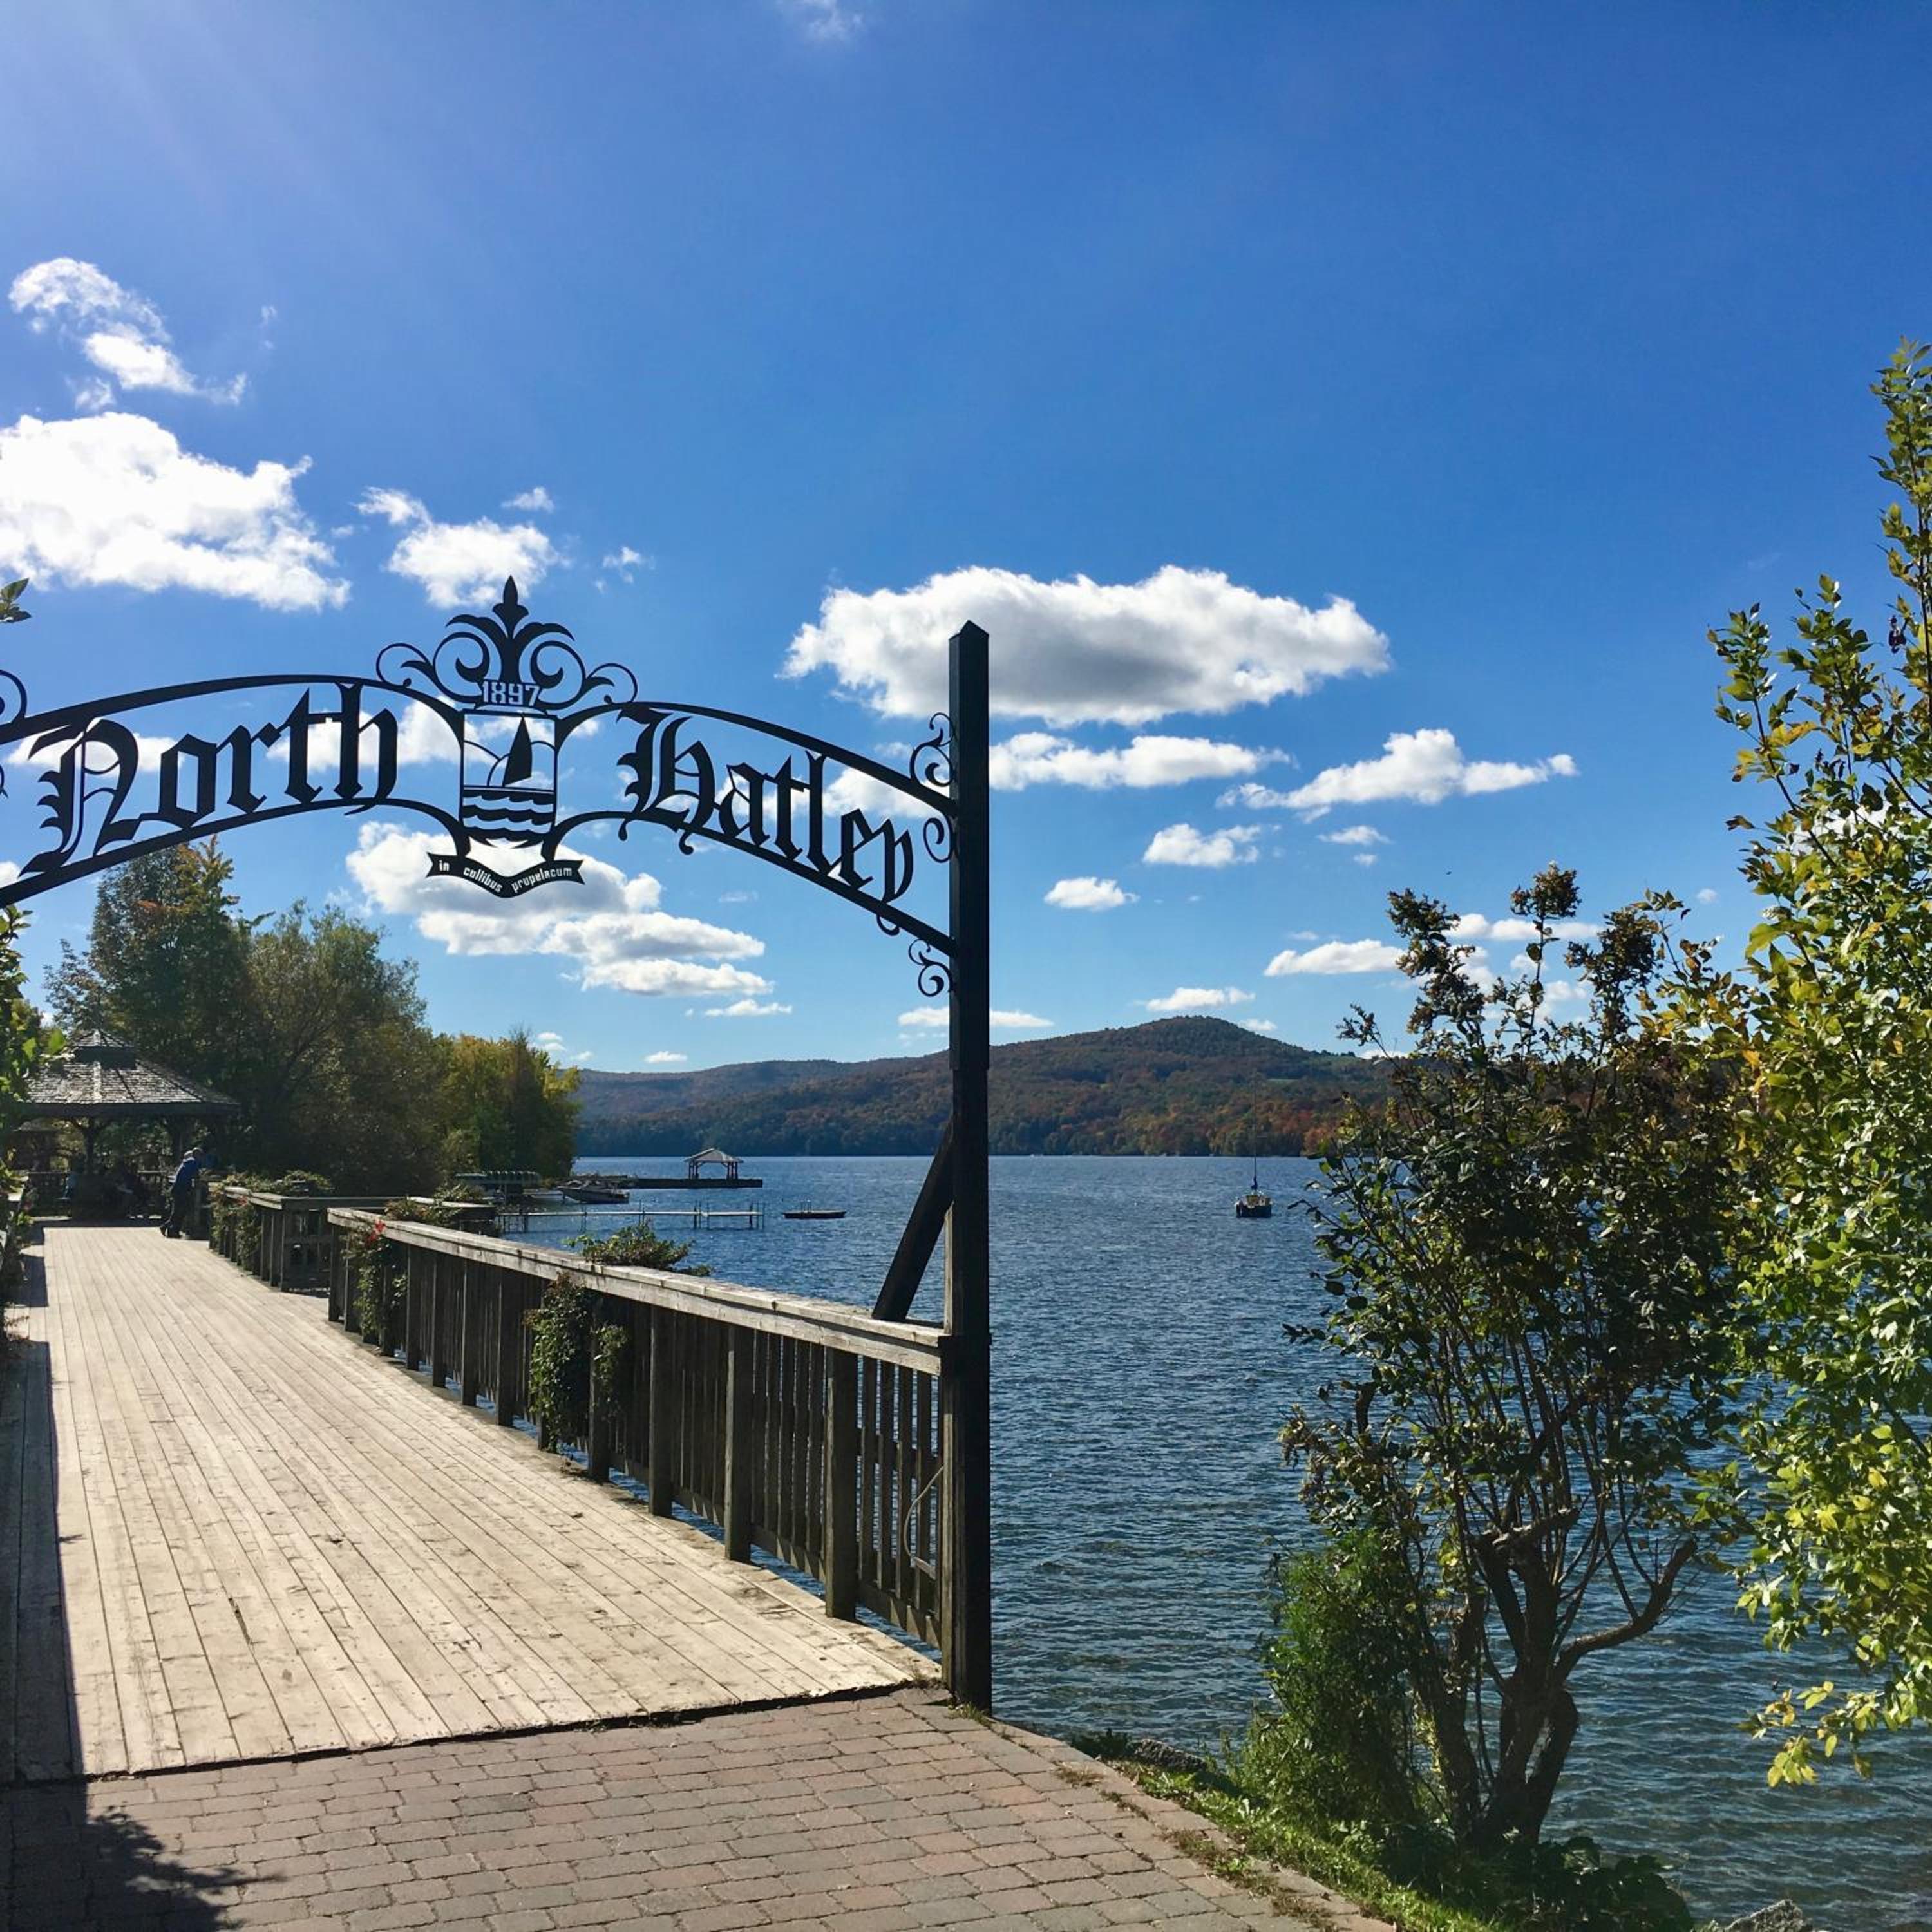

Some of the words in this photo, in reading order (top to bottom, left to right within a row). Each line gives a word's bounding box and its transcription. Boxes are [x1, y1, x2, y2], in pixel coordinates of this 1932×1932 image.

[483, 681, 540, 706] 1897
[19, 683, 398, 877] North
[616, 708, 913, 934] Hatley
[439, 860, 449, 871] in
